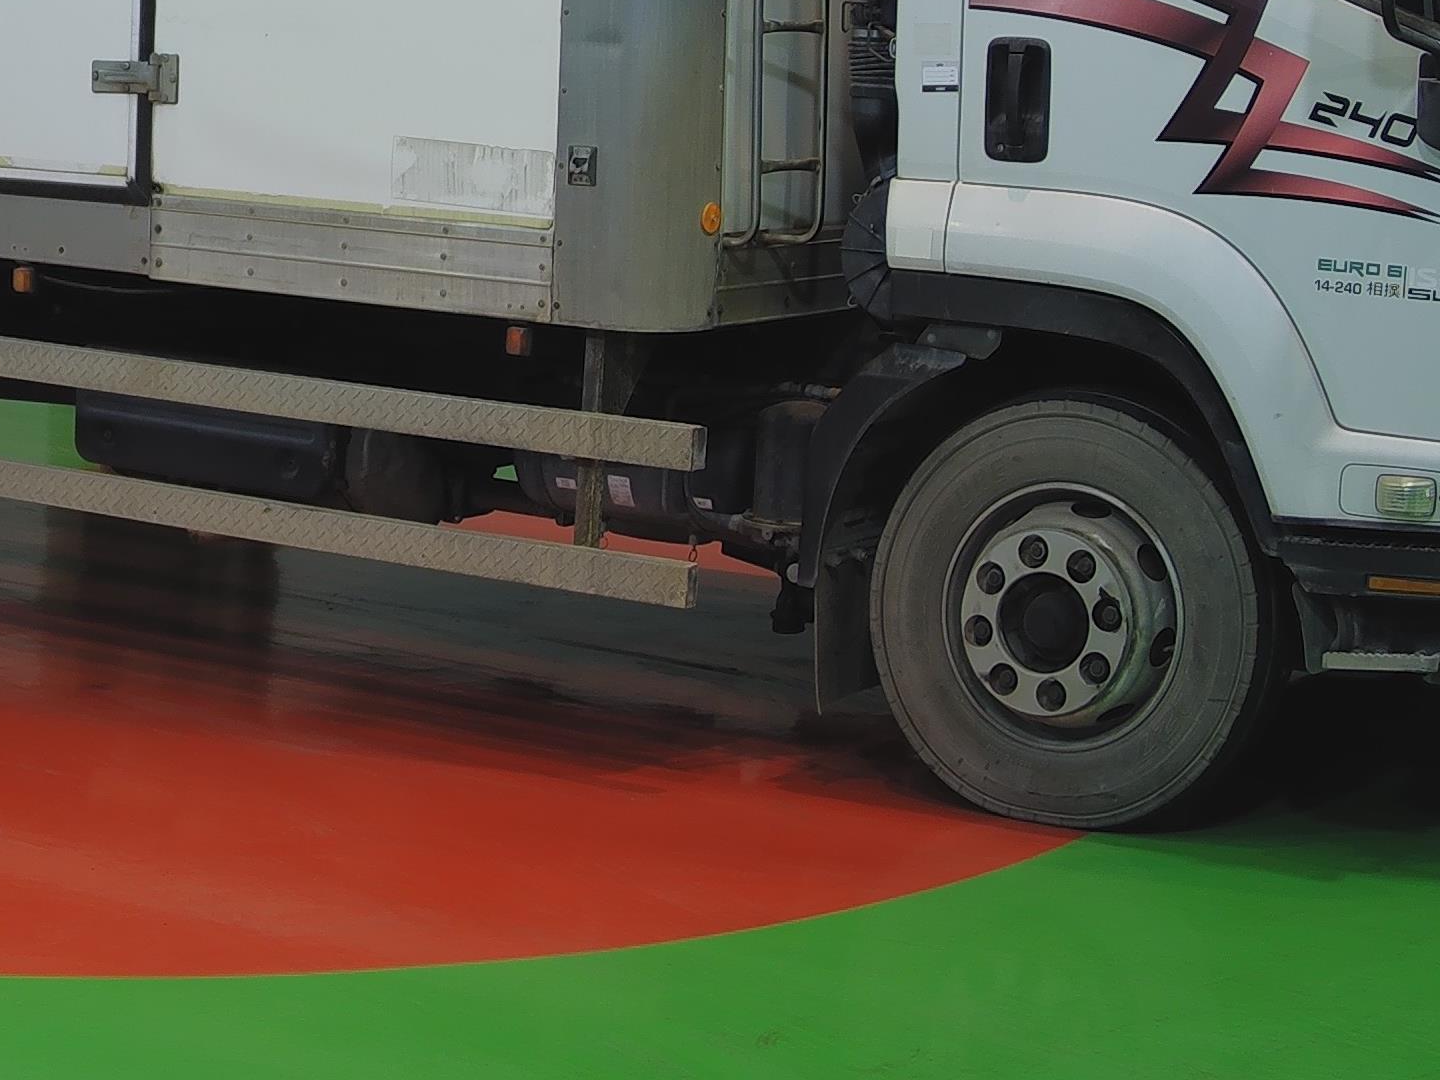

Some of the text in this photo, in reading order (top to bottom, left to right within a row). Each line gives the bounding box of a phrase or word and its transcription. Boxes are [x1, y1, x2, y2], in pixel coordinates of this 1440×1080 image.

[1308, 91, 1418, 148] 240
[1318, 258, 1402, 278] EURO 6
[1315, 279, 1362, 295] 14-240
